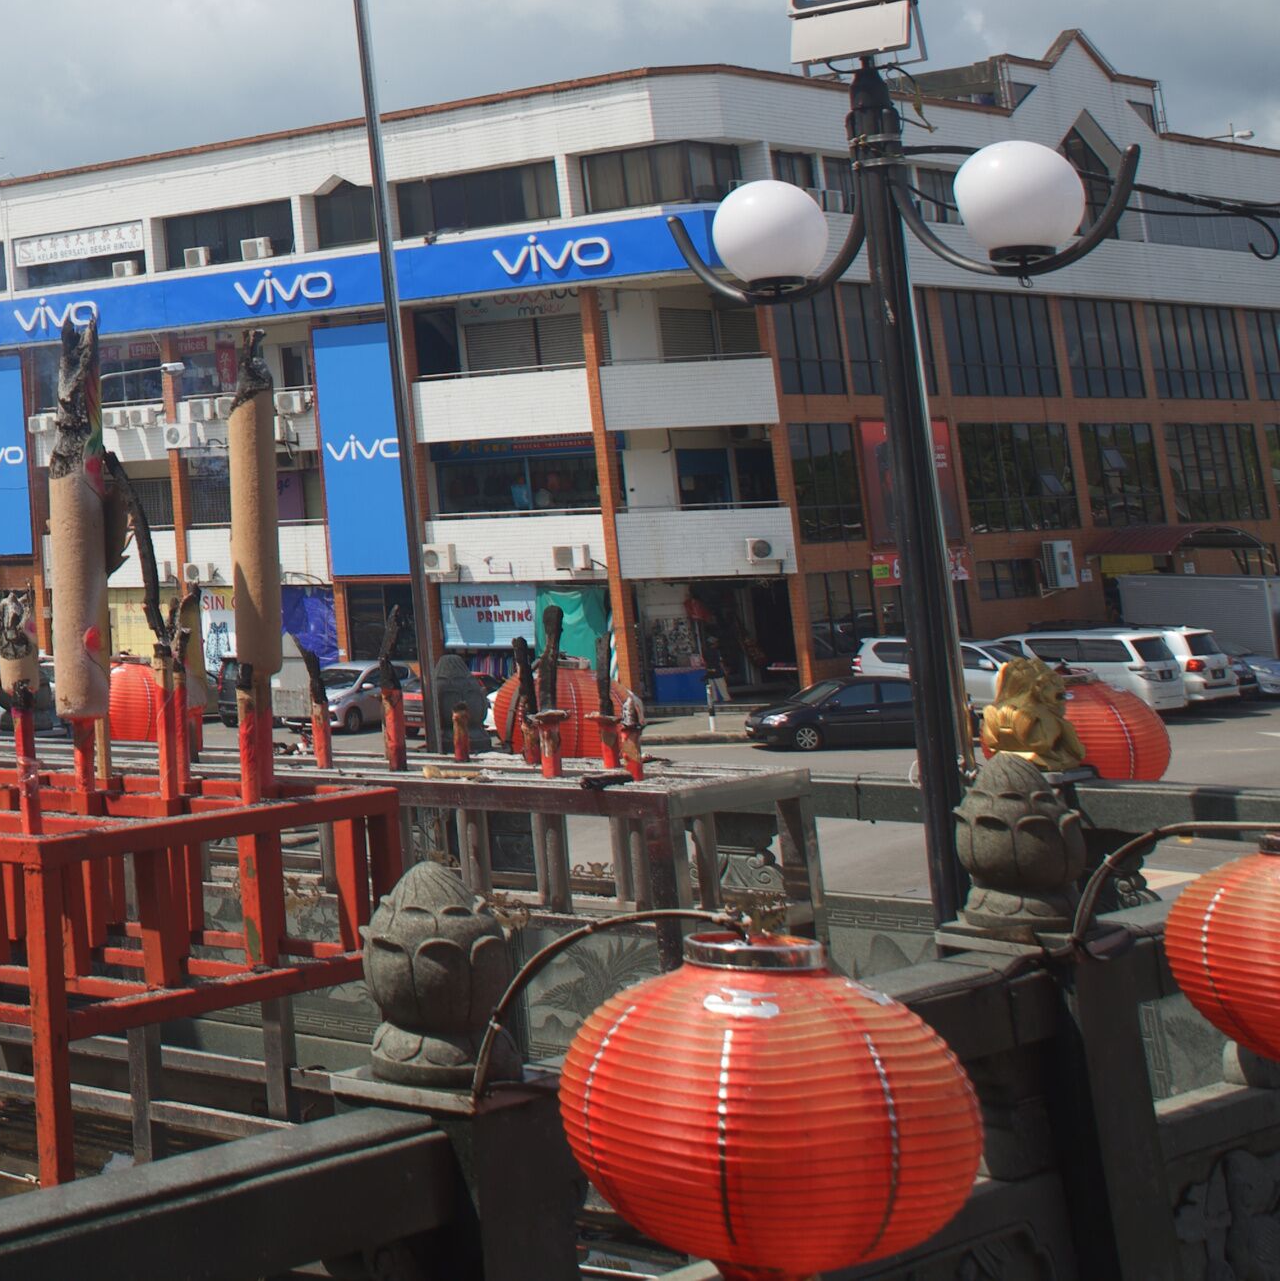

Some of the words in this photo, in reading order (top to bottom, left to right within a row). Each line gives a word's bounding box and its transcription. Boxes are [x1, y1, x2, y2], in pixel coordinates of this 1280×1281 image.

[492, 234, 612, 276] vivo
[234, 269, 334, 306] vivo
[14, 298, 99, 332] vivo
[326, 434, 400, 461] vivo
[203, 596, 225, 610] SIN
[454, 594, 500, 608] LANZIDA
[477, 608, 533, 623] PRINTING
